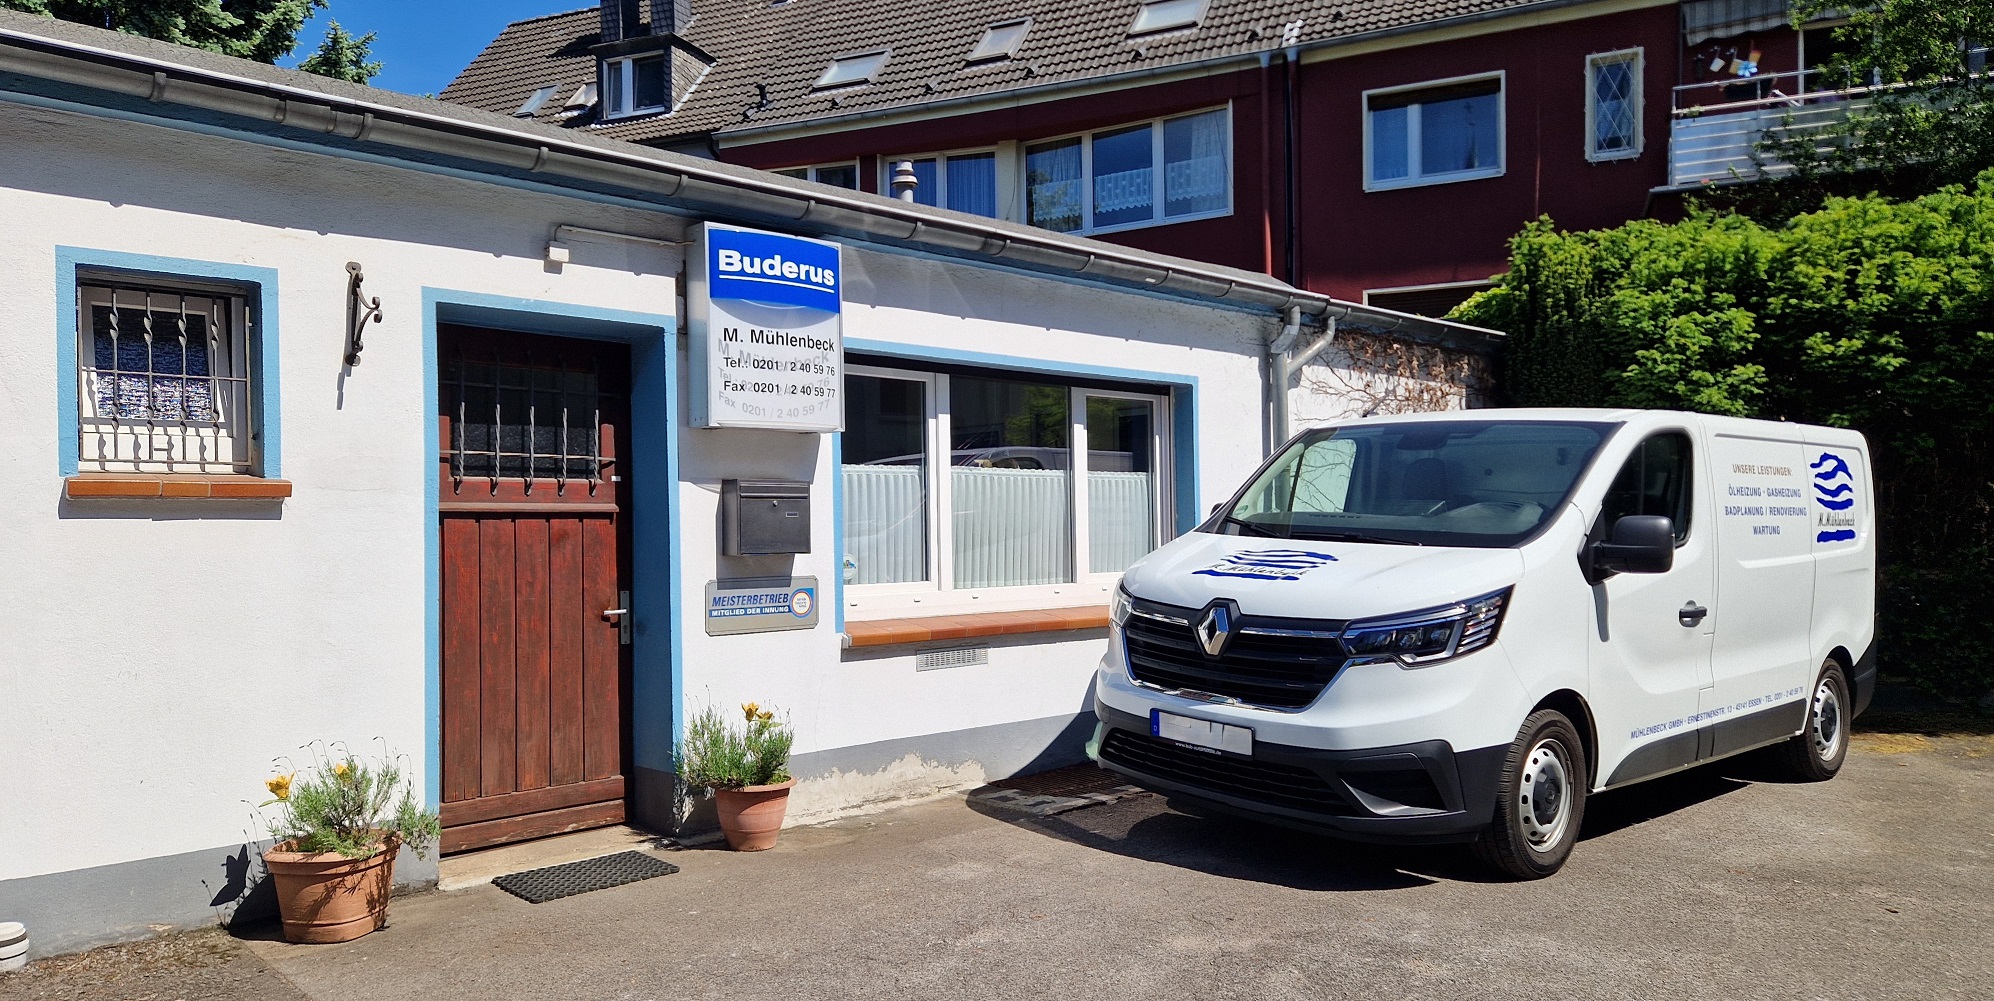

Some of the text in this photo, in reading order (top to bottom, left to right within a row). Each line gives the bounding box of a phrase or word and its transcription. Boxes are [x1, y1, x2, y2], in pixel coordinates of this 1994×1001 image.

[718, 249, 835, 286] Buderus
[723, 327, 835, 352] M. Mühlenbeck
[723, 357, 748, 369] Tel.:
[752, 358, 780, 370] 0201
[790, 361, 796, 372] 2
[800, 363, 811, 373] 40
[813, 364, 824, 375] 59
[826, 366, 836, 377] 76
[723, 380, 745, 392] Fax
[753, 382, 780, 394] 0201
[790, 384, 797, 395] 2
[800, 385, 812, 396] 40
[814, 387, 825, 397] 59
[826, 388, 836, 398] 77
[1732, 464, 1757, 474] UNSERE
[1728, 484, 1762, 497] ÖLHEIZUNG
[1766, 488, 1802, 498] GASHEIZUNG
[1724, 506, 1764, 516] BADPLANUNG
[1769, 507, 1808, 517] RENOVIERUNG
[1752, 525, 1781, 535] WARTUNG
[711, 593, 789, 607] MEISTERBETRIEB
[711, 608, 745, 616] MITGLIED
[746, 607, 761, 615] DER
[1631, 722, 1667, 738] MÜHLENBECK
[1668, 718, 1684, 730] GMBH
[1748, 697, 1763, 708] ESSEN
